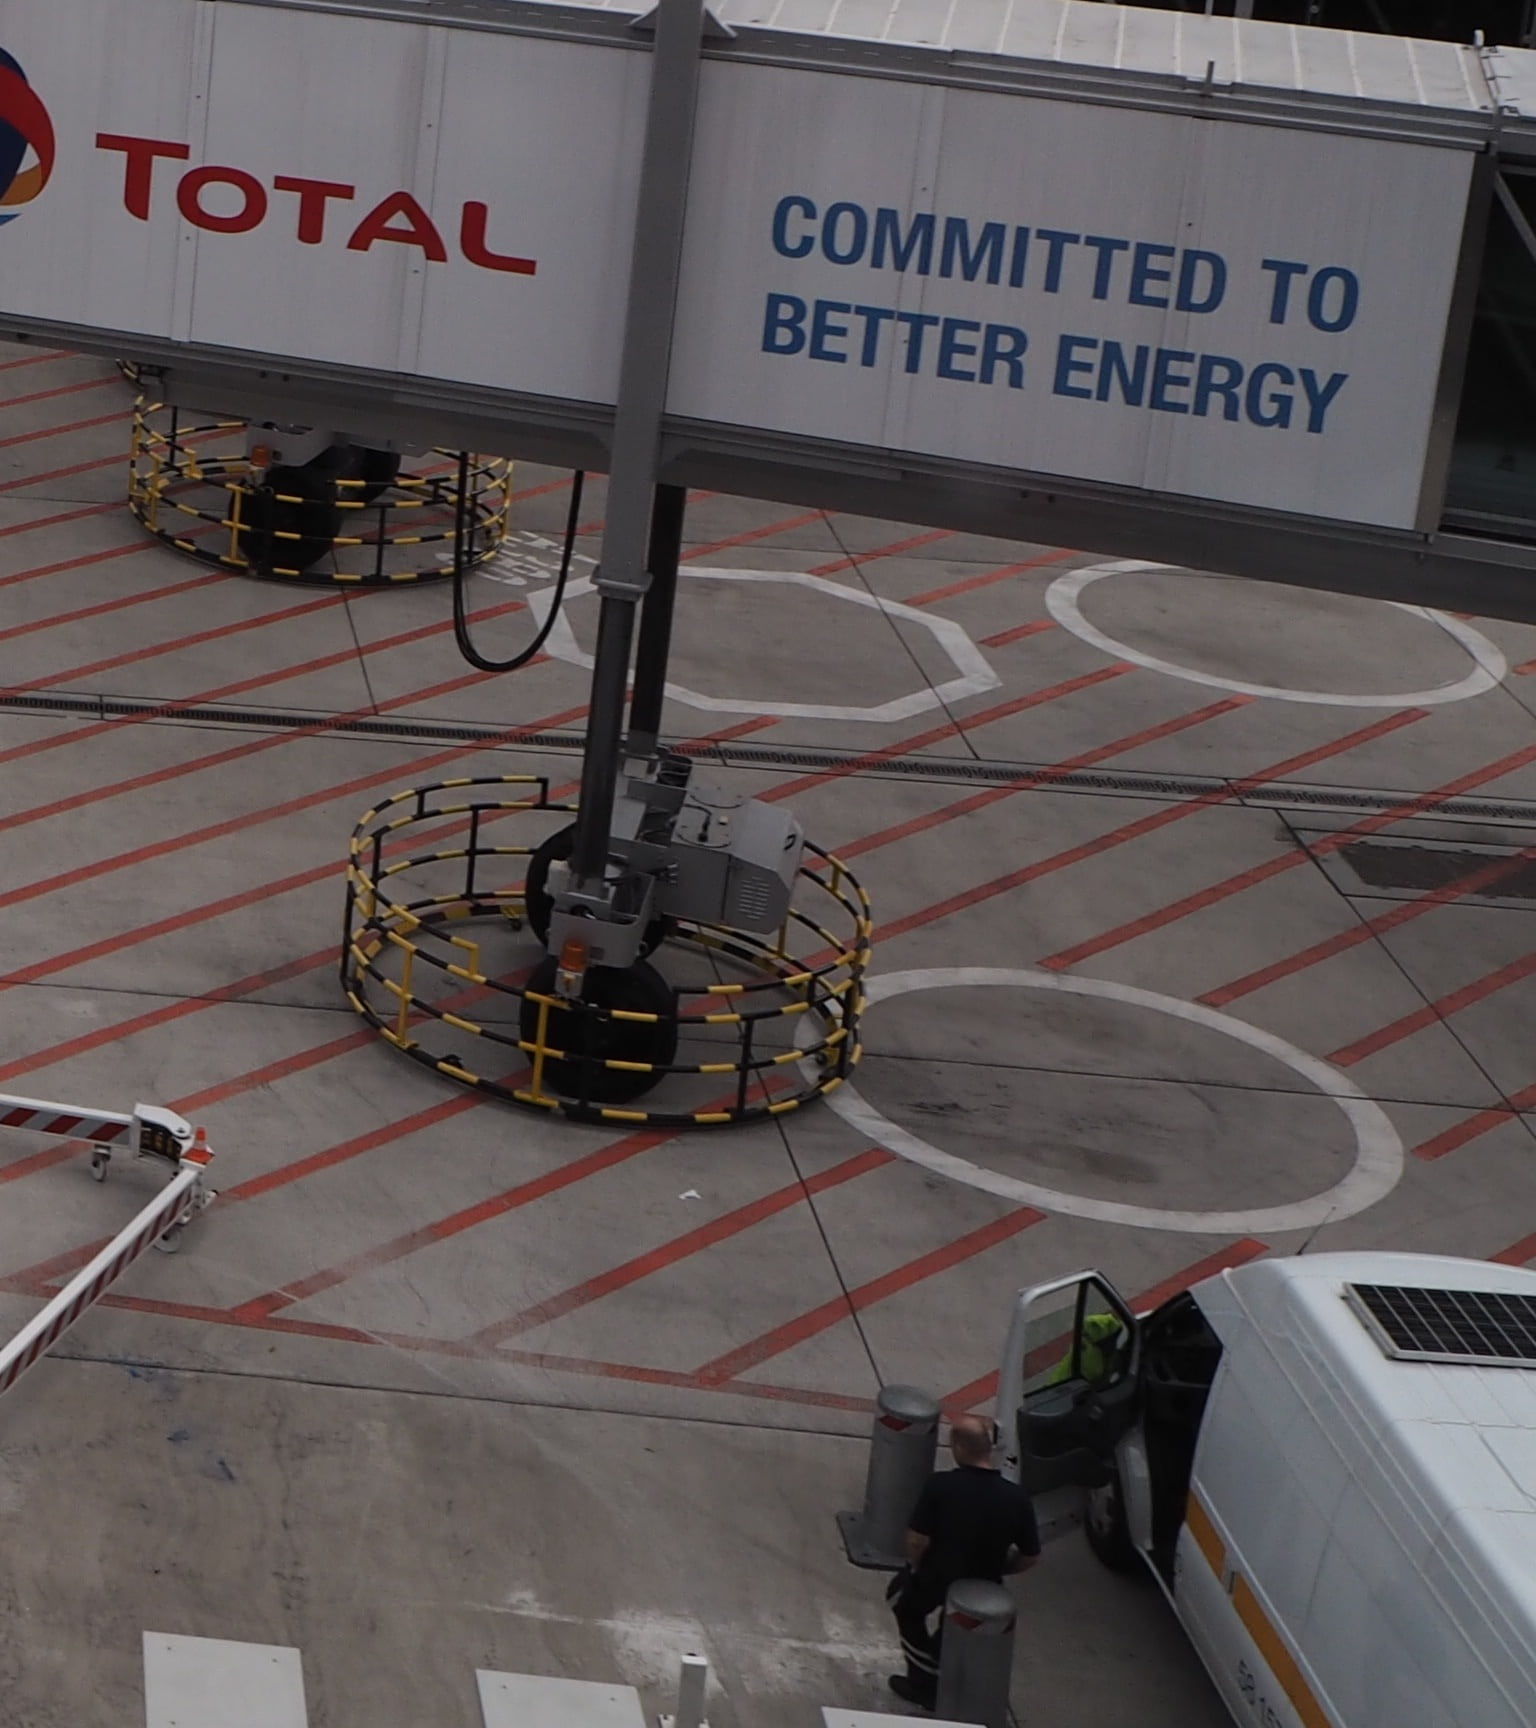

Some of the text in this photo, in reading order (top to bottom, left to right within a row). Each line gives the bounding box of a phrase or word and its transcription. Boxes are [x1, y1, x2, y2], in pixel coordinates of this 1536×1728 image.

[95, 134, 537, 275] TOTAL
[772, 195, 1360, 333] COMMITTED TO
[762, 292, 1349, 434] BETTER ENERGY
